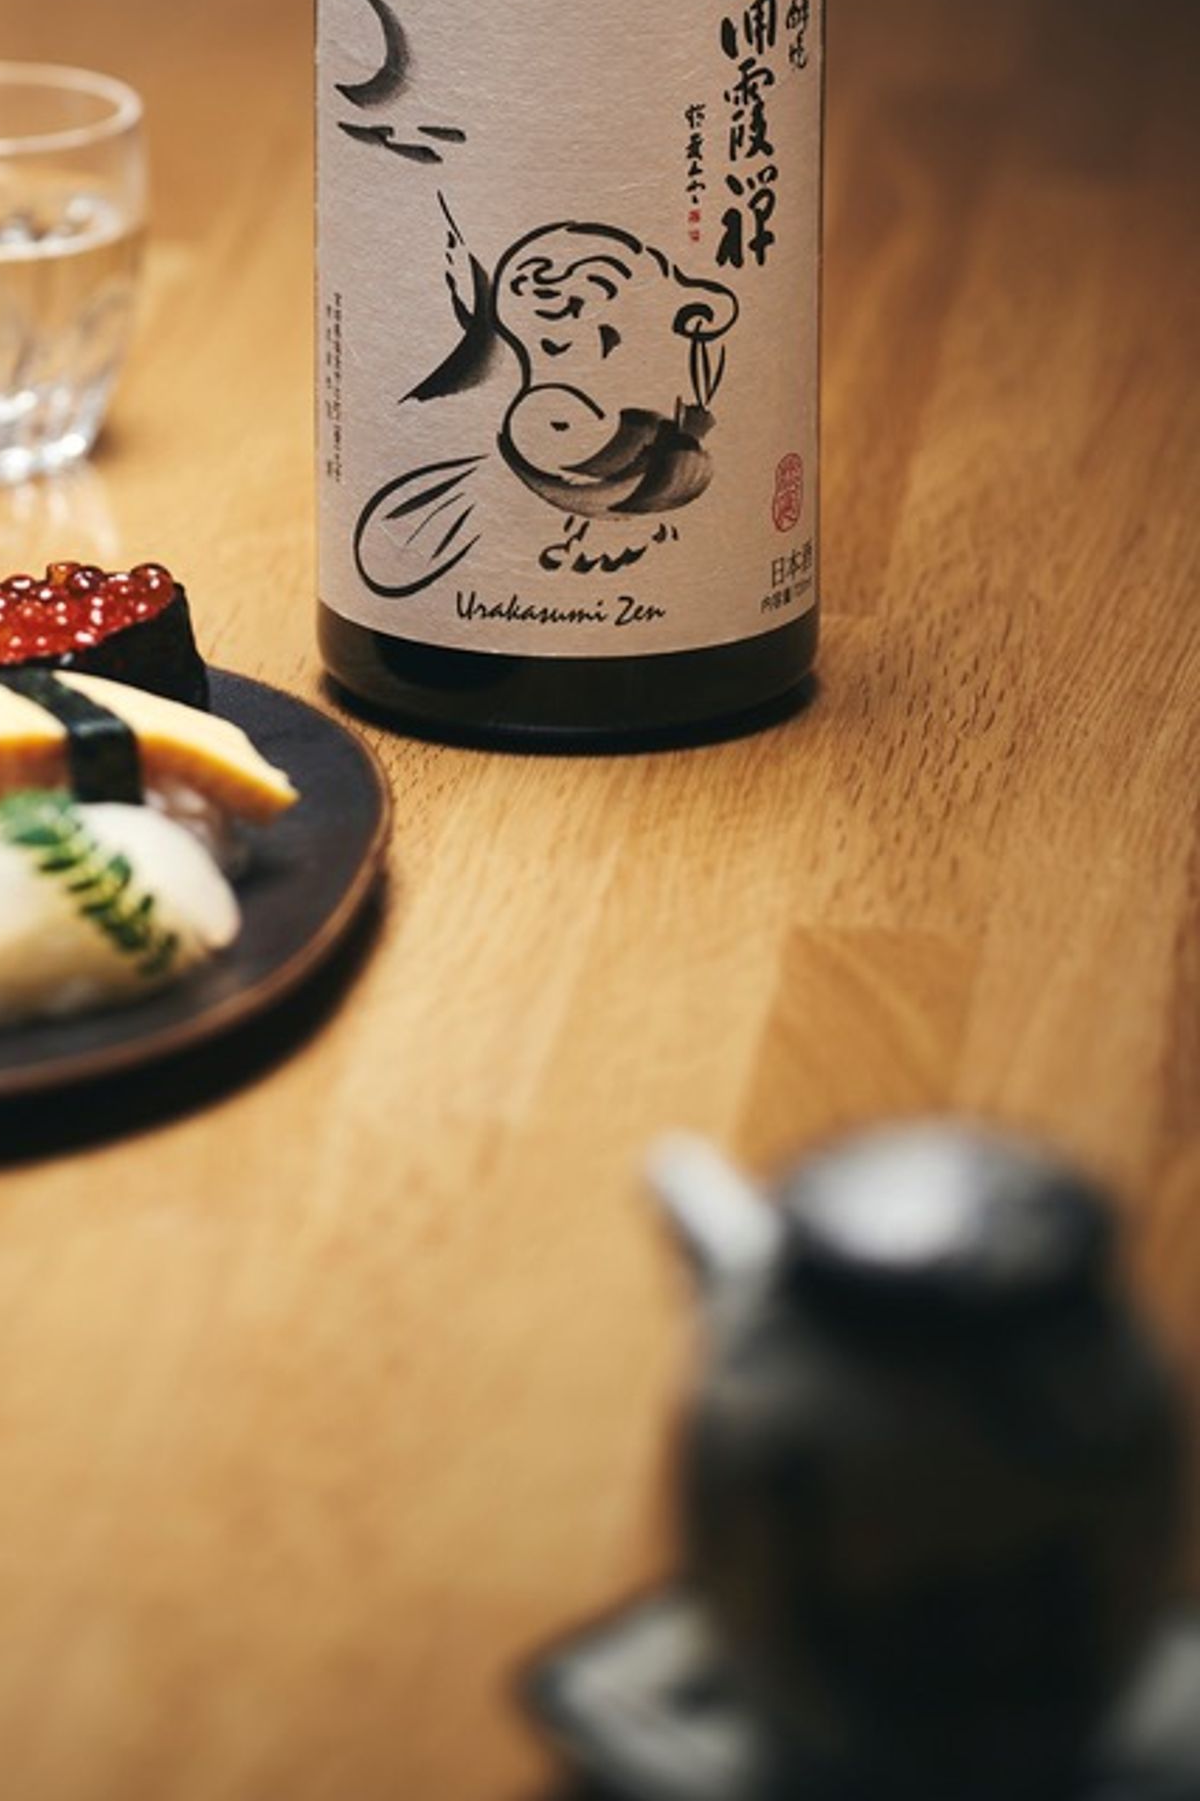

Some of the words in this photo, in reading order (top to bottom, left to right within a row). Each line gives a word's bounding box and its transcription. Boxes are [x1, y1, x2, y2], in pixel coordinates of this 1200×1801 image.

[772, 537, 813, 589] 日本酒
[456, 591, 607, 624] Urakasumi
[614, 596, 666, 626] Zen
